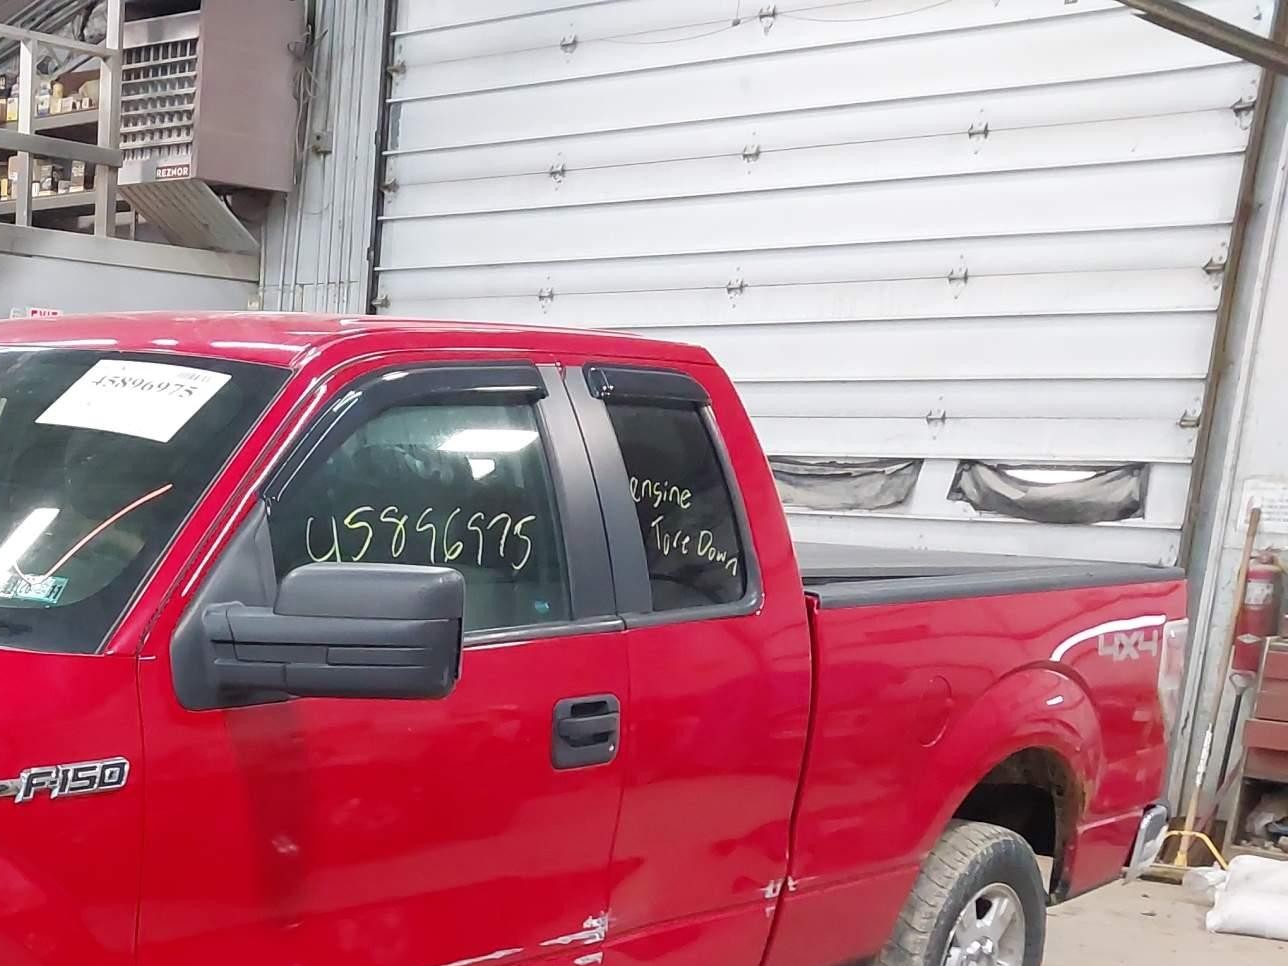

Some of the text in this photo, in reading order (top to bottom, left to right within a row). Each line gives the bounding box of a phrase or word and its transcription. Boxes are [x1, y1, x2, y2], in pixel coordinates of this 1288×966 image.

[156, 166, 189, 178] REZNOR
[91, 375, 198, 398] 45896975
[697, 530, 738, 576] Down
